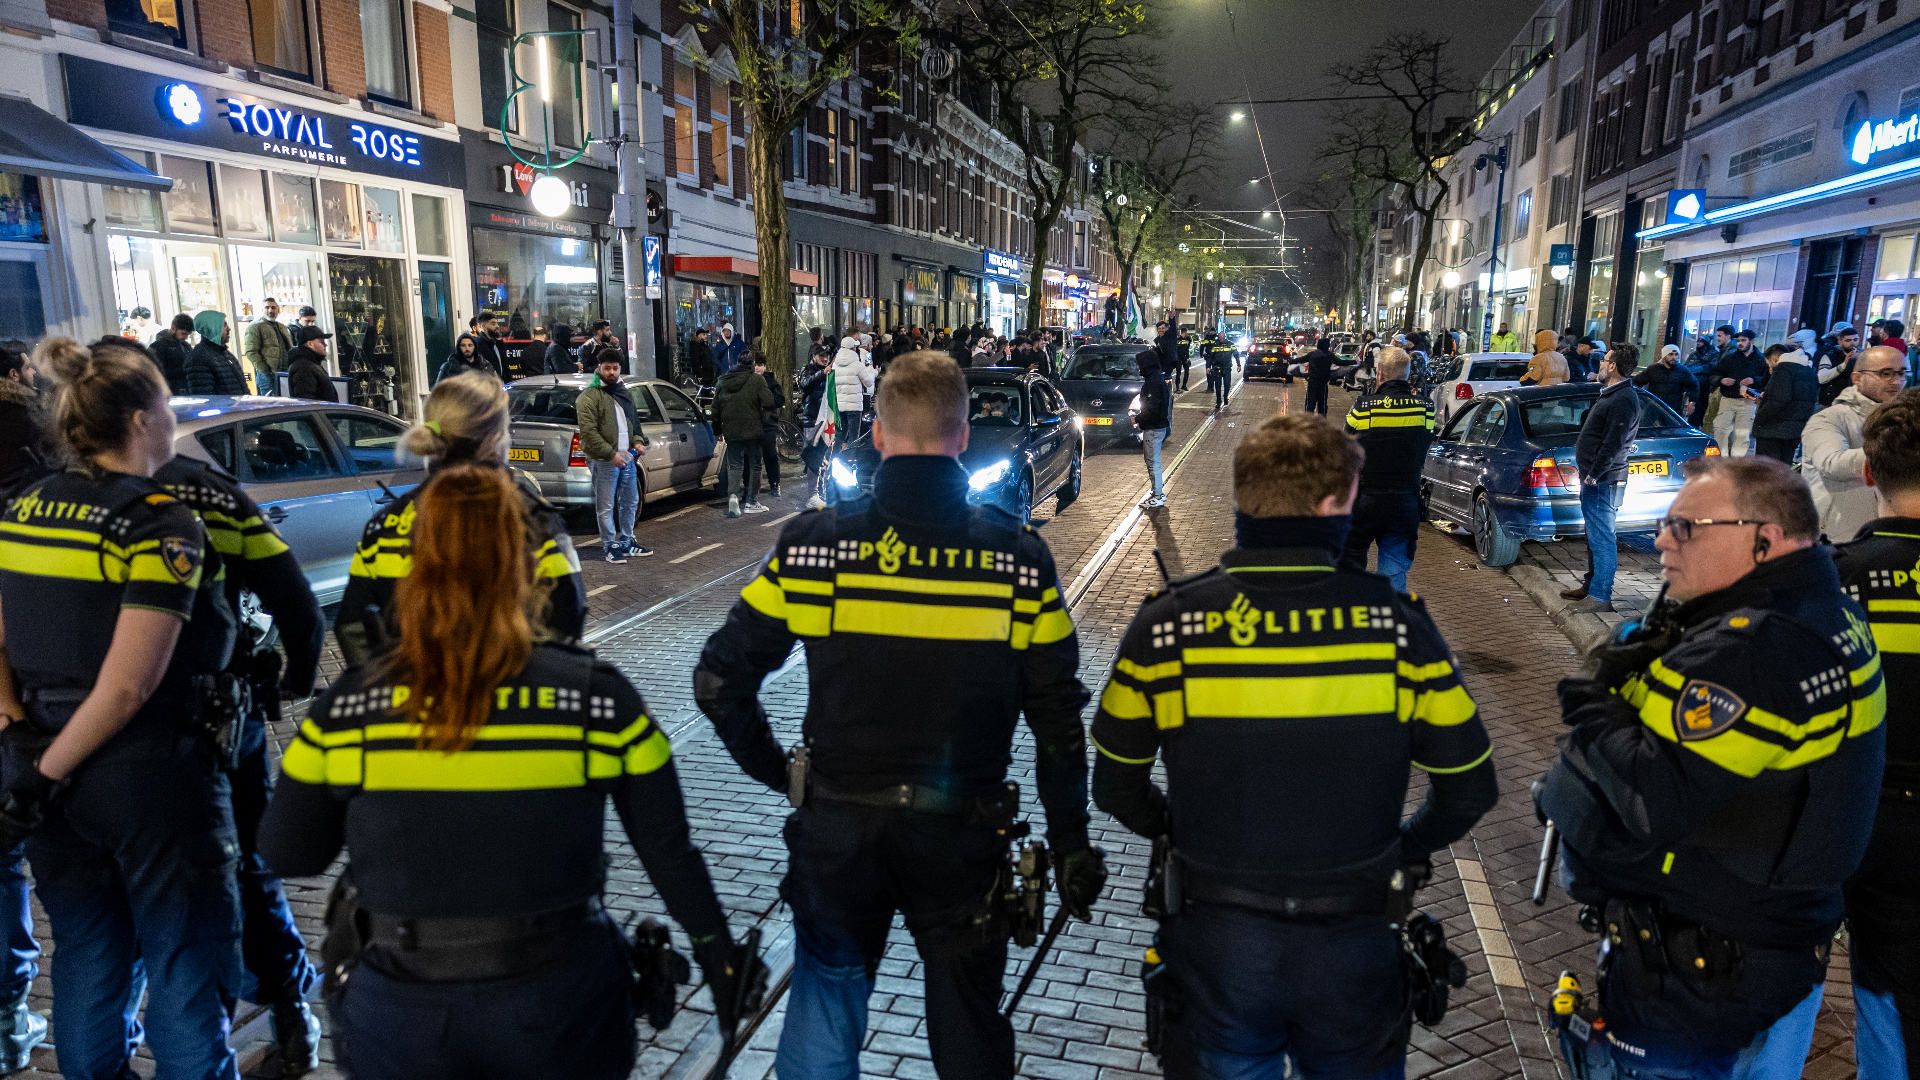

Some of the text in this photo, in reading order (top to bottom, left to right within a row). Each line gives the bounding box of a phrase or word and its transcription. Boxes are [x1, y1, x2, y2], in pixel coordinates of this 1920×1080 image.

[227, 97, 420, 166] ROYAL ROSE
[1870, 113, 1918, 153] Albert
[263, 142, 347, 165] PARFUMERIE
[515, 169, 533, 183] Love
[527, 218, 549, 230] Delivery
[555, 222, 577, 234] Catering
[12, 487, 92, 522] POLITIE
[858, 526, 995, 574] POLITIE
[1206, 592, 1370, 646] POLITIE
[391, 685, 556, 711] PTIE
